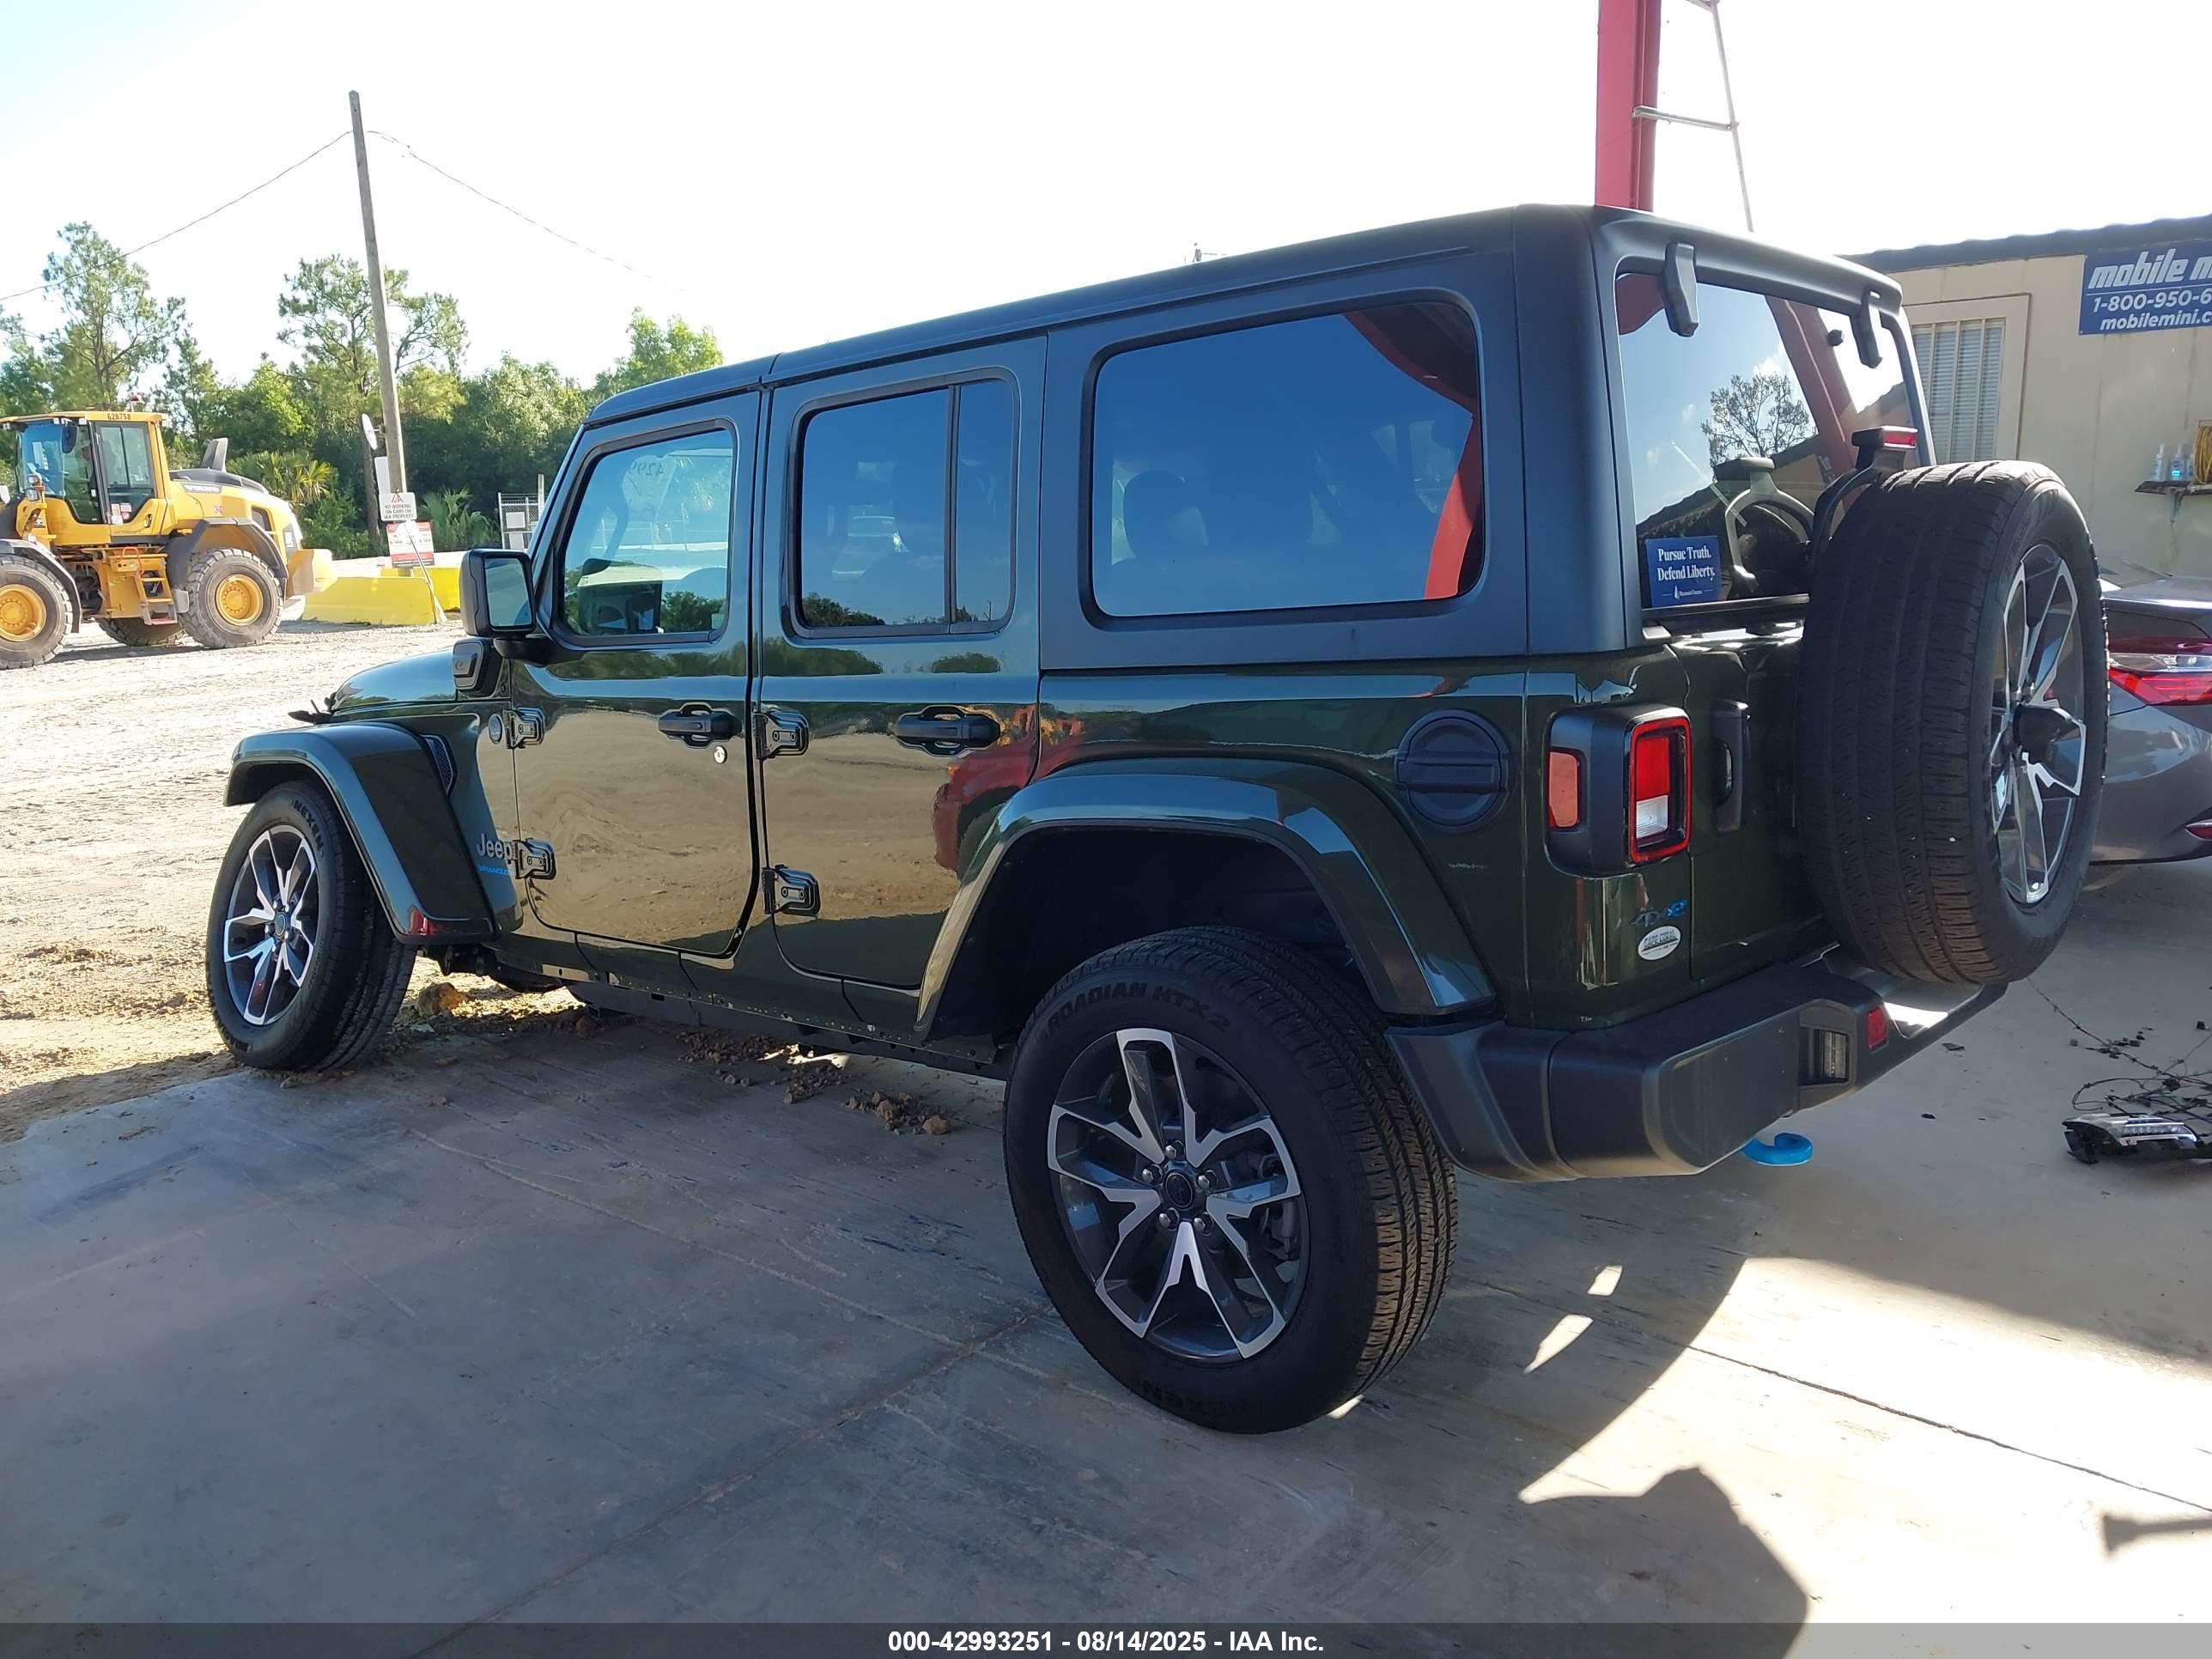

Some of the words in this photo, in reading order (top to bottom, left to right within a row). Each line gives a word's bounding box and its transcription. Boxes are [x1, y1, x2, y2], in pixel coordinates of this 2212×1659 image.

[2087, 248, 2189, 289] mobile
[1657, 548, 1686, 562] Pursue
[1686, 545, 1711, 559] Truth.
[1656, 565, 1686, 581] Defend
[1686, 564, 1715, 580] Liberty.
[293, 799, 324, 852] NEXEN
[477, 832, 513, 864] Jeep
[1047, 981, 1147, 1036] ROADIAN
